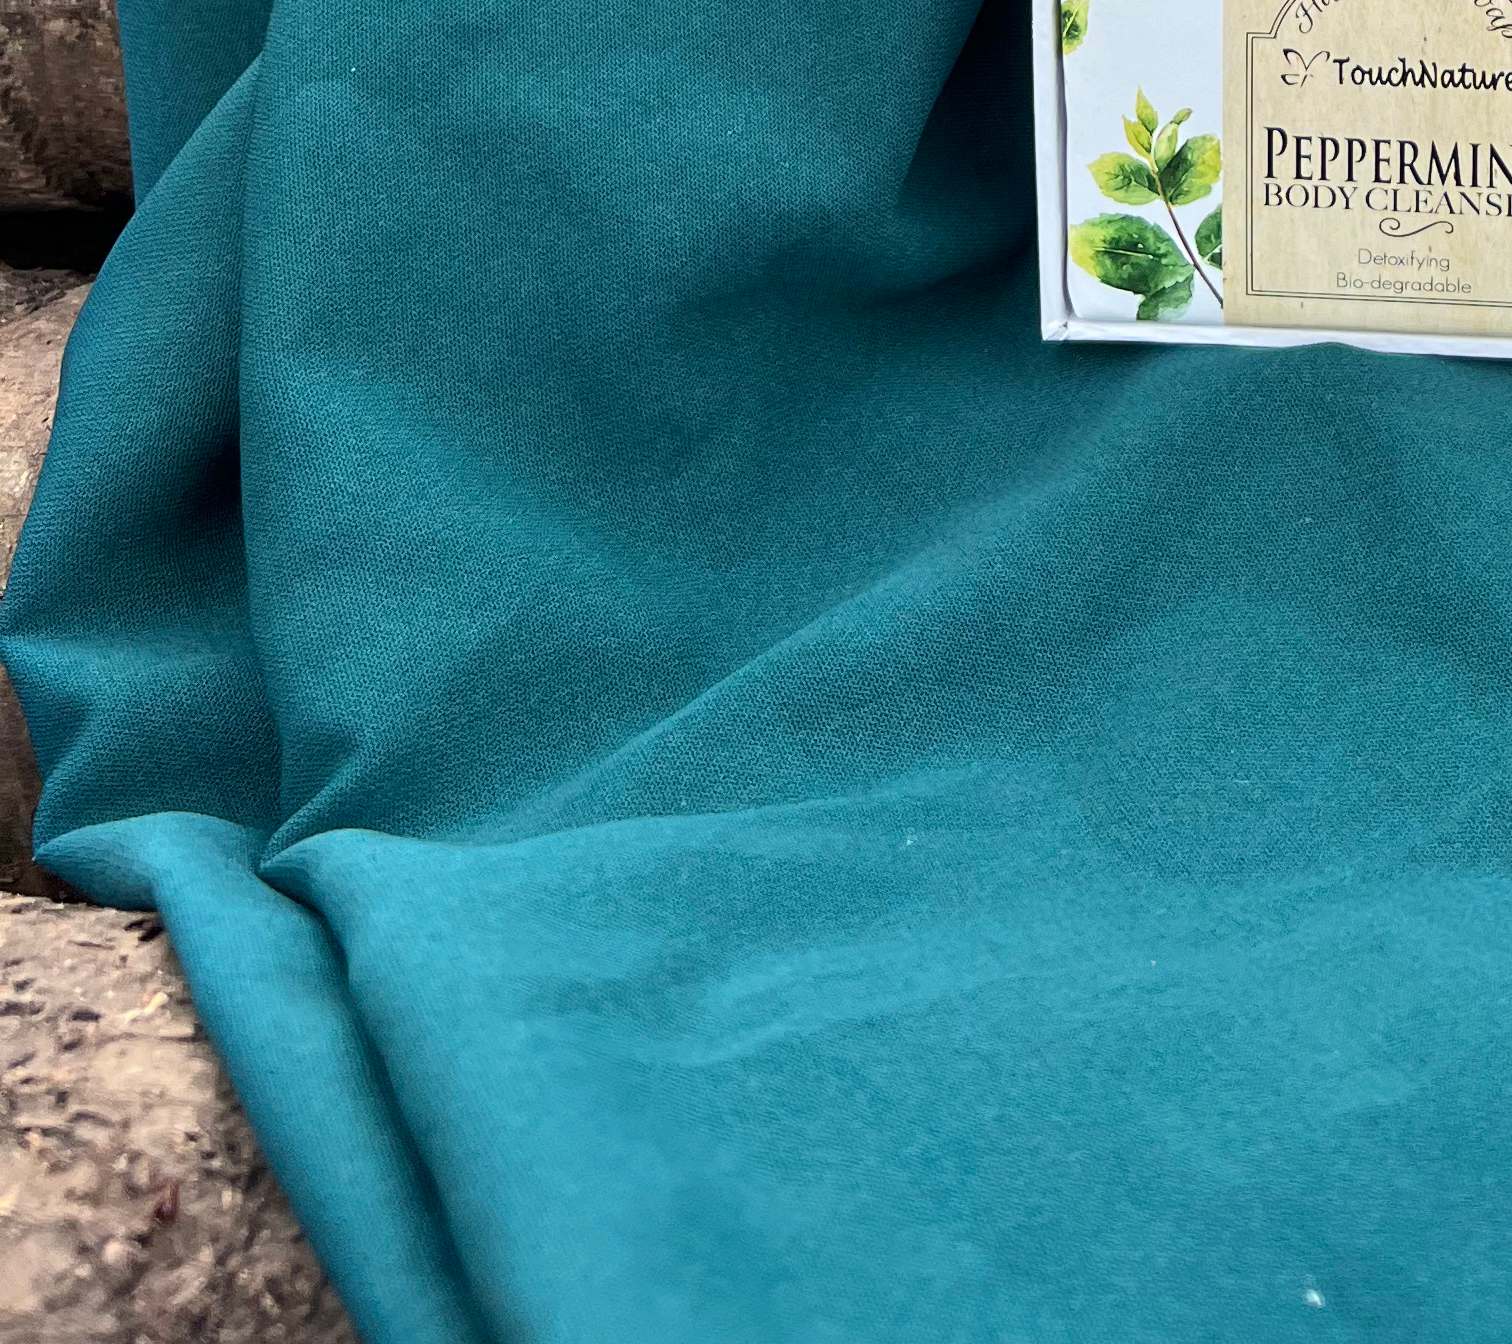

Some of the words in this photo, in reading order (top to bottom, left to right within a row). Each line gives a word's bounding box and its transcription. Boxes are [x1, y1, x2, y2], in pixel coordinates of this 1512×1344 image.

[1263, 183, 1356, 210] BODY
[1358, 249, 1450, 272] Detoxifying
[1336, 272, 1472, 295] Bio-degradable
